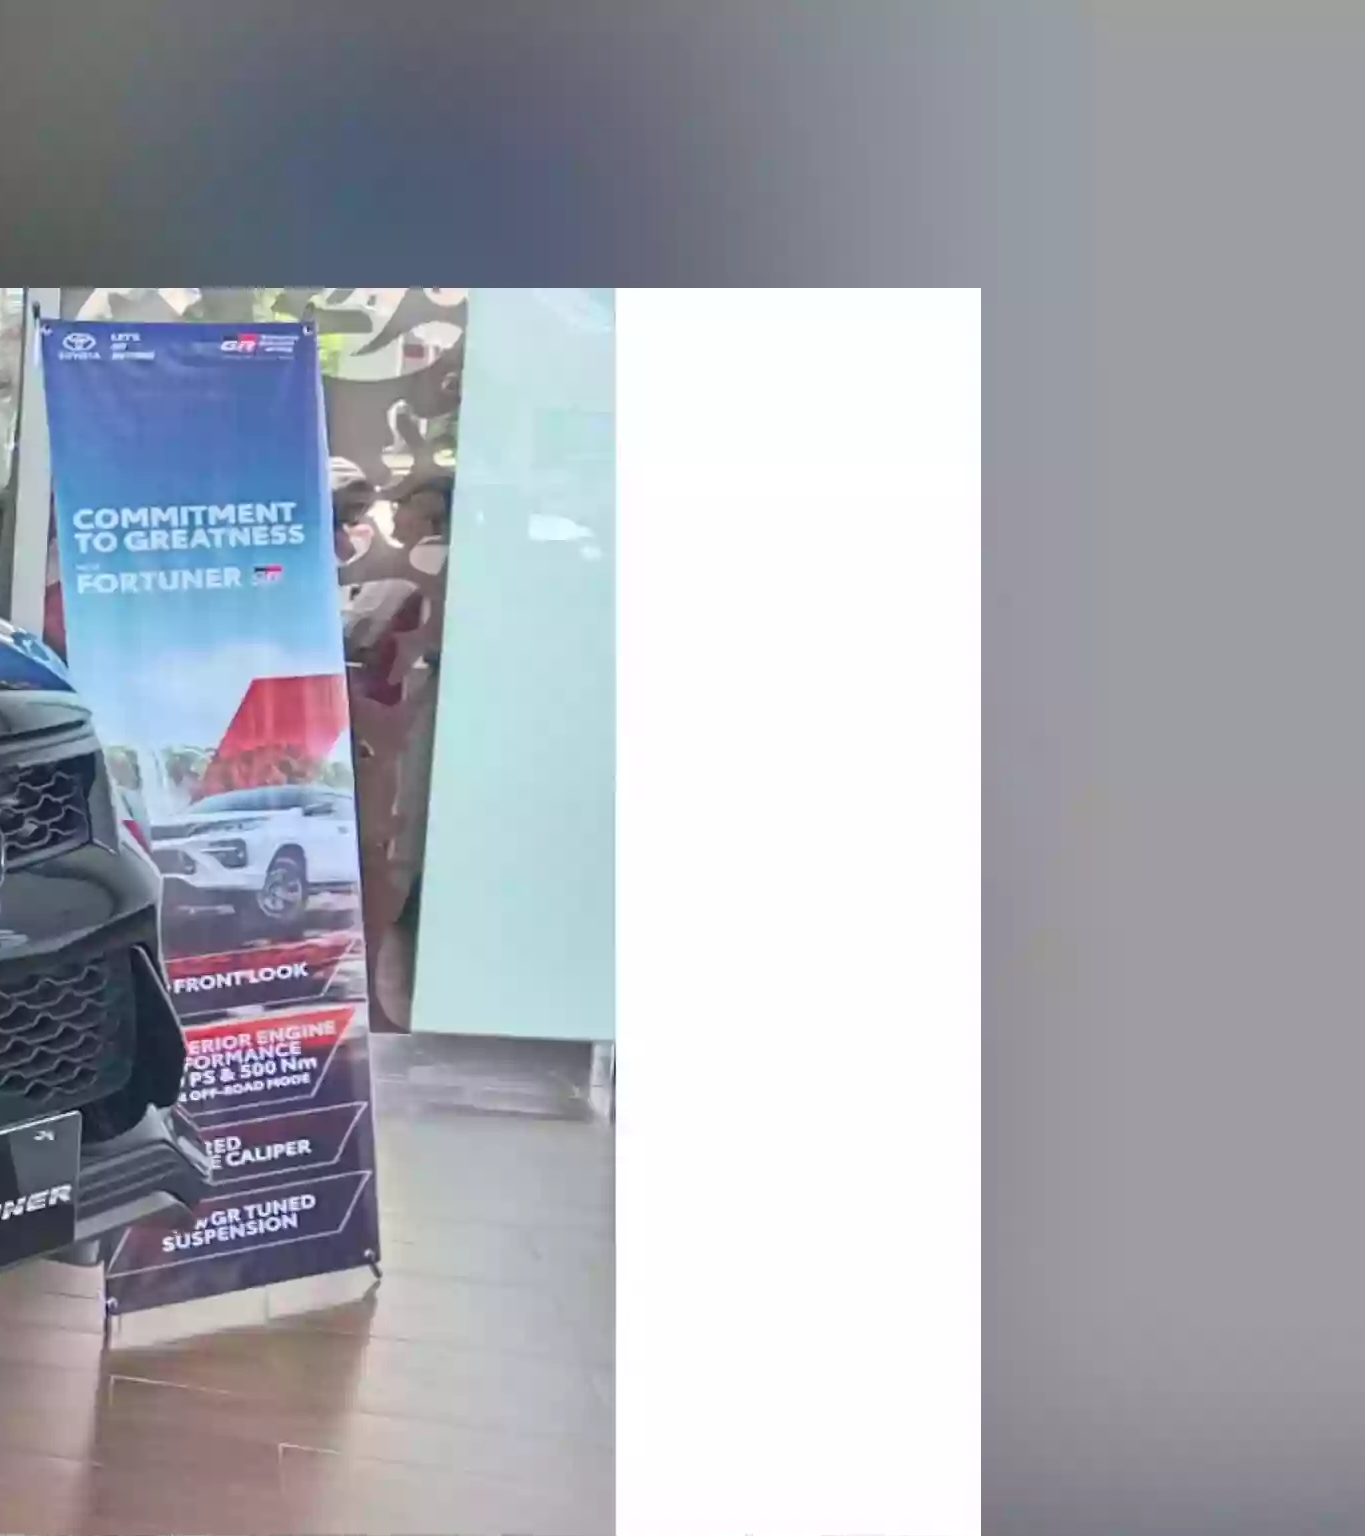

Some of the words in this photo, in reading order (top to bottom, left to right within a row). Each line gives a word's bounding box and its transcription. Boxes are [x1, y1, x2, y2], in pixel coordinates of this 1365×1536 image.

[72, 502, 297, 530] COMMITMENT
[73, 530, 118, 554] TO
[123, 524, 305, 552] GREATNESS
[76, 567, 242, 595] FORTUNER
[173, 970, 245, 995] FRONT
[245, 961, 309, 984] LOOK
[188, 1033, 252, 1056] ERIOR
[257, 1020, 337, 1045] ENGINE
[185, 1041, 302, 1073] FORMANCE
[189, 1067, 216, 1088] PS
[220, 1067, 235, 1083] &
[240, 1059, 277, 1079] 500
[281, 1057, 317, 1074] Nm
[267, 1072, 311, 1089] MODE
[226, 1139, 312, 1168] CALIPER
[211, 1209, 241, 1226] GR
[243, 1193, 317, 1217] TUNED
[162, 1213, 299, 1252] SUSPENSION
